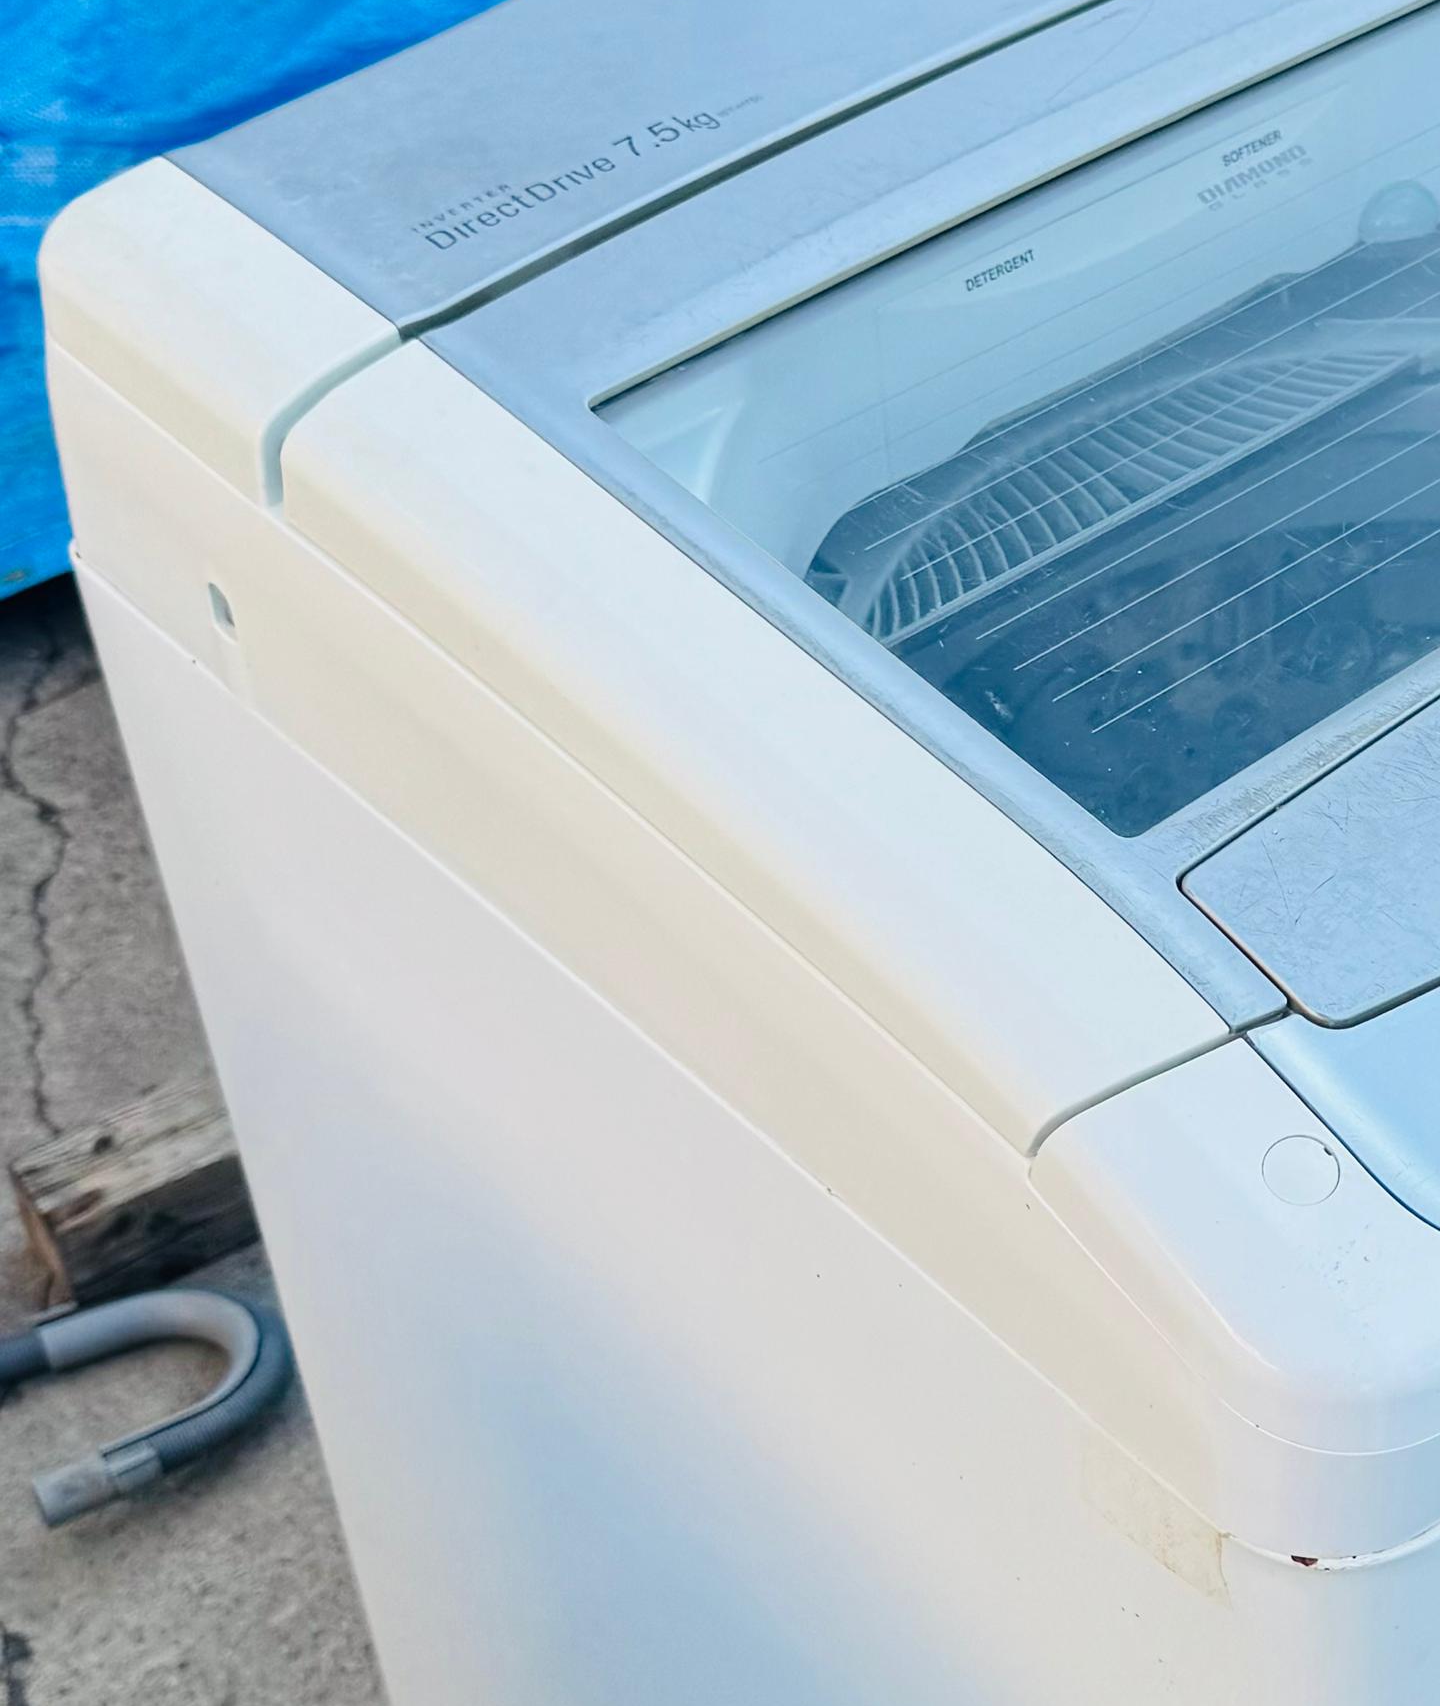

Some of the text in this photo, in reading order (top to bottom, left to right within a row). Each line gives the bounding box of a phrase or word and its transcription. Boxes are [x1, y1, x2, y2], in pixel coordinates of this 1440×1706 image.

[1221, 129, 1282, 168] SOFTENER
[1197, 144, 1307, 207] DIAMOND
[411, 183, 511, 234] INVERTER
[964, 248, 1036, 293] DETERGENT
